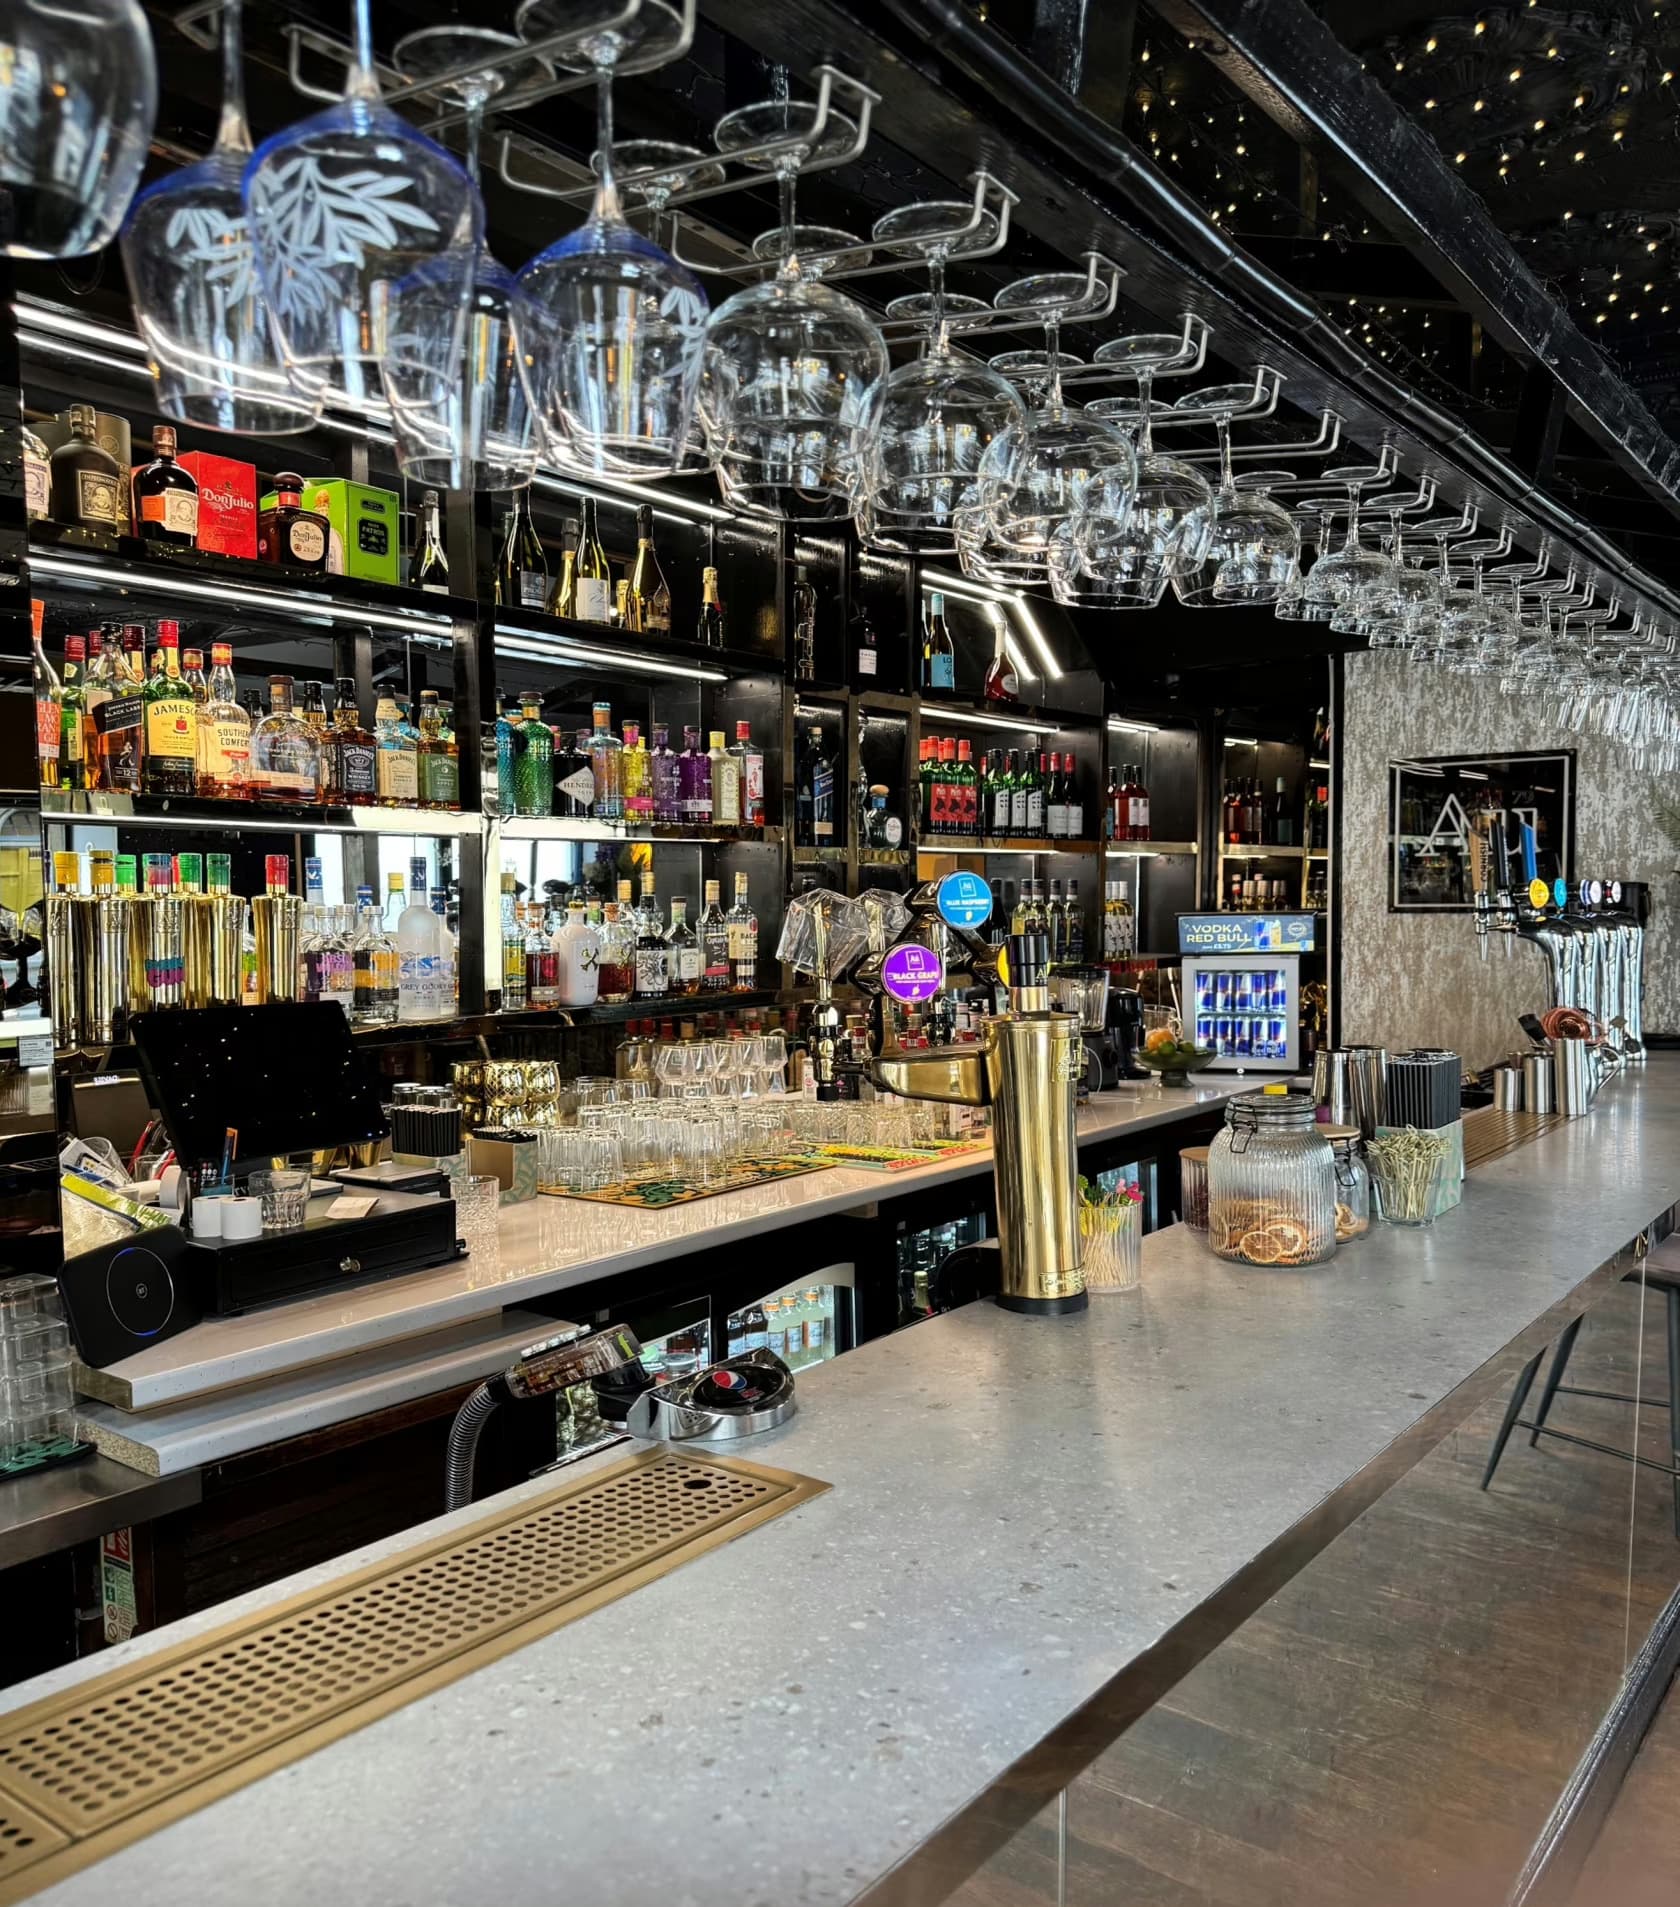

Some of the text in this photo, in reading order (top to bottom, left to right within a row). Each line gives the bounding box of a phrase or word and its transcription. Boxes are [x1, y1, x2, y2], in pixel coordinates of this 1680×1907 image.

[1191, 924, 1243, 934] VODKA
[1186, 933, 1252, 943] RED BULL
